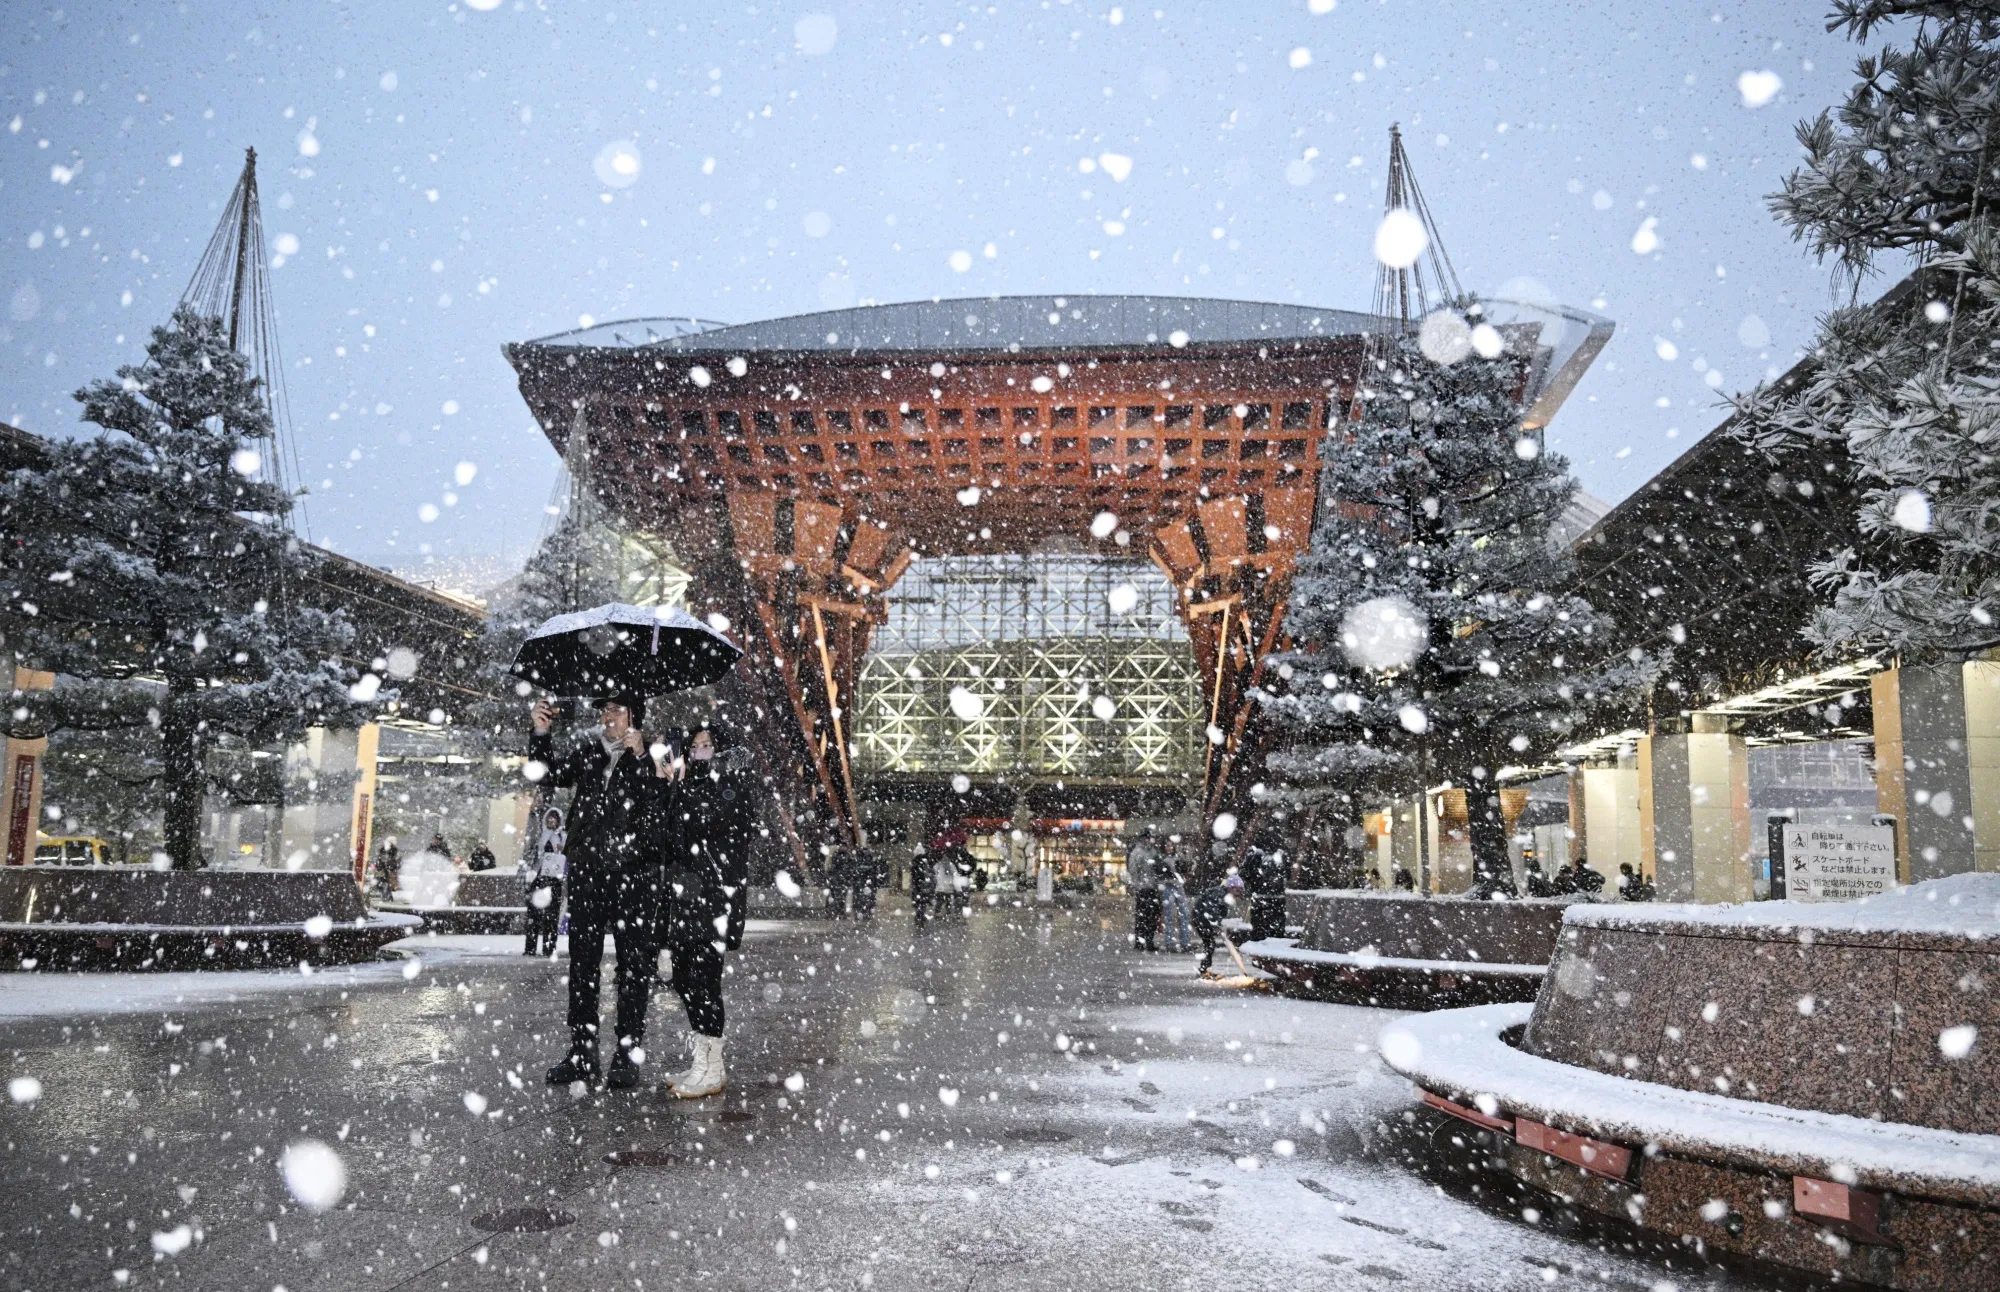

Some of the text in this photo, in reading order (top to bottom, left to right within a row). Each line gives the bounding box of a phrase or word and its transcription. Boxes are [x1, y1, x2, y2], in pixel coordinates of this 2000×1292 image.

[1811, 832, 1844, 841] 自転車は
[1812, 855, 1870, 865] スケートボード
[1813, 877, 1883, 889] 指定場所以外での
